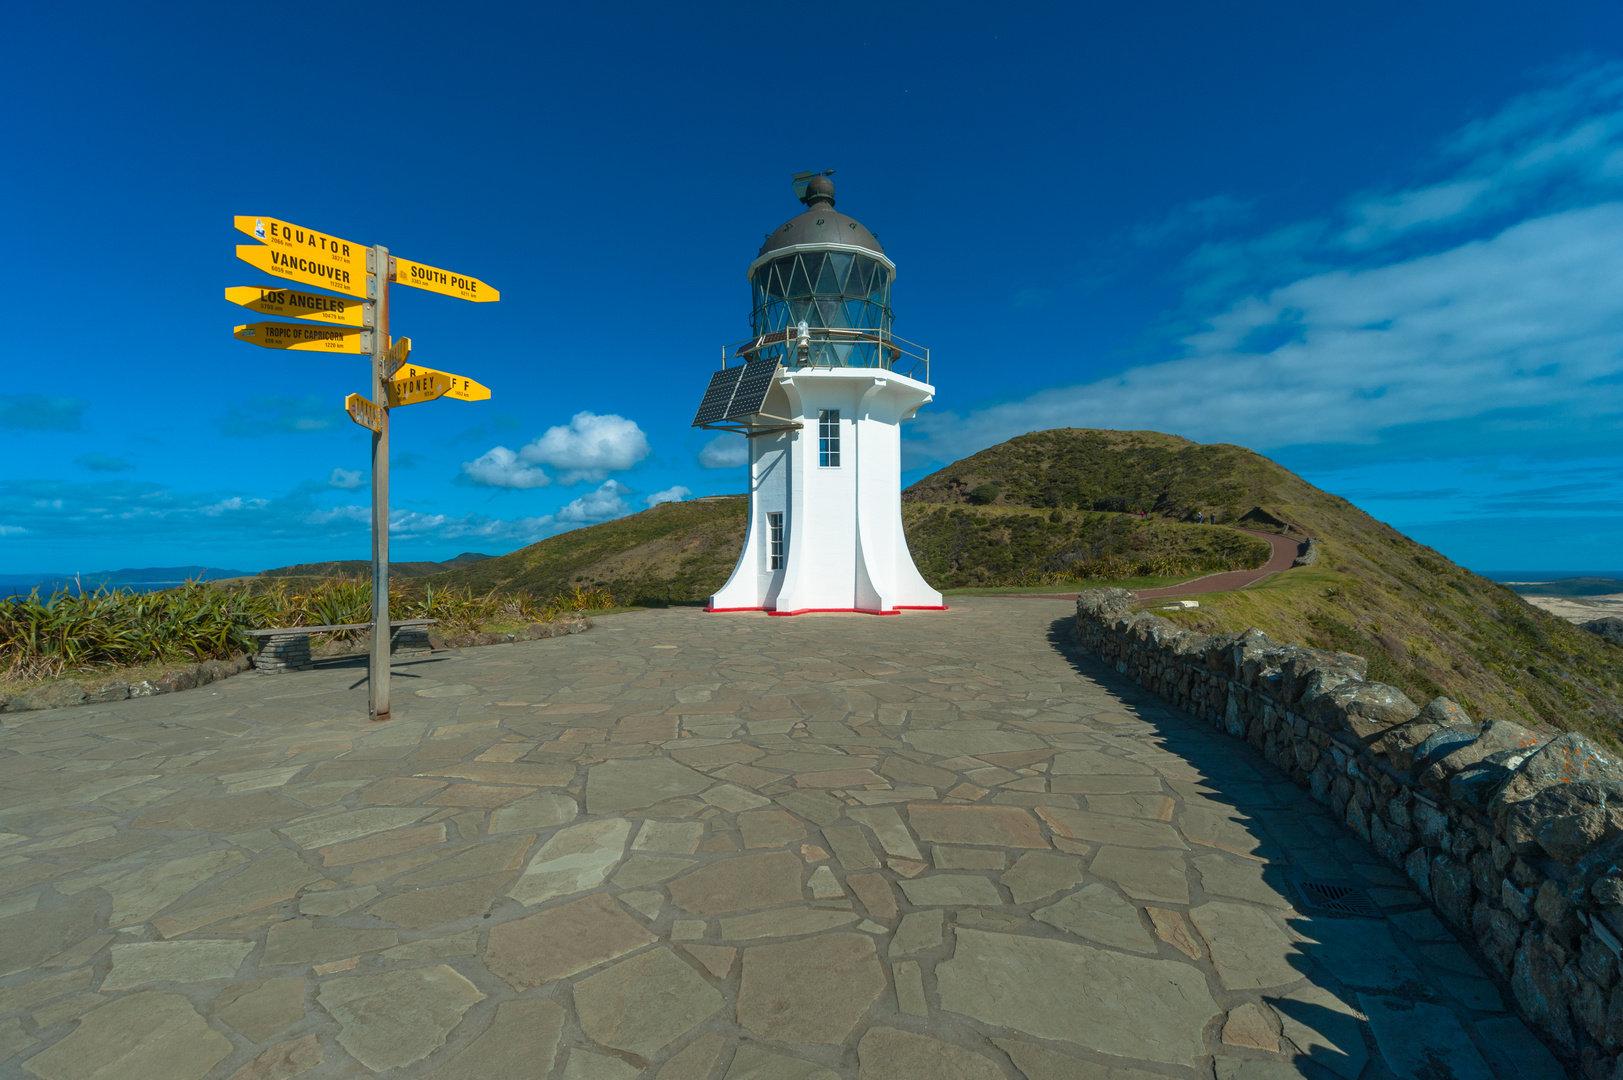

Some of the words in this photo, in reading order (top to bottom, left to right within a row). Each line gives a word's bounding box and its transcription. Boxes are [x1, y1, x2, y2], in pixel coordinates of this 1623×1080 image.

[271, 222, 350, 257] EQUATOR
[270, 250, 350, 283] VANCOUVER
[411, 265, 447, 285] SOUTH
[451, 276, 477, 292] POLE
[260, 290, 285, 305] LOS
[289, 294, 345, 313] ANGELES
[265, 327, 291, 338] TROPIC
[293, 329, 302, 338] OF
[304, 330, 344, 341] CAPRICORN
[396, 376, 434, 395] SYDNEY
